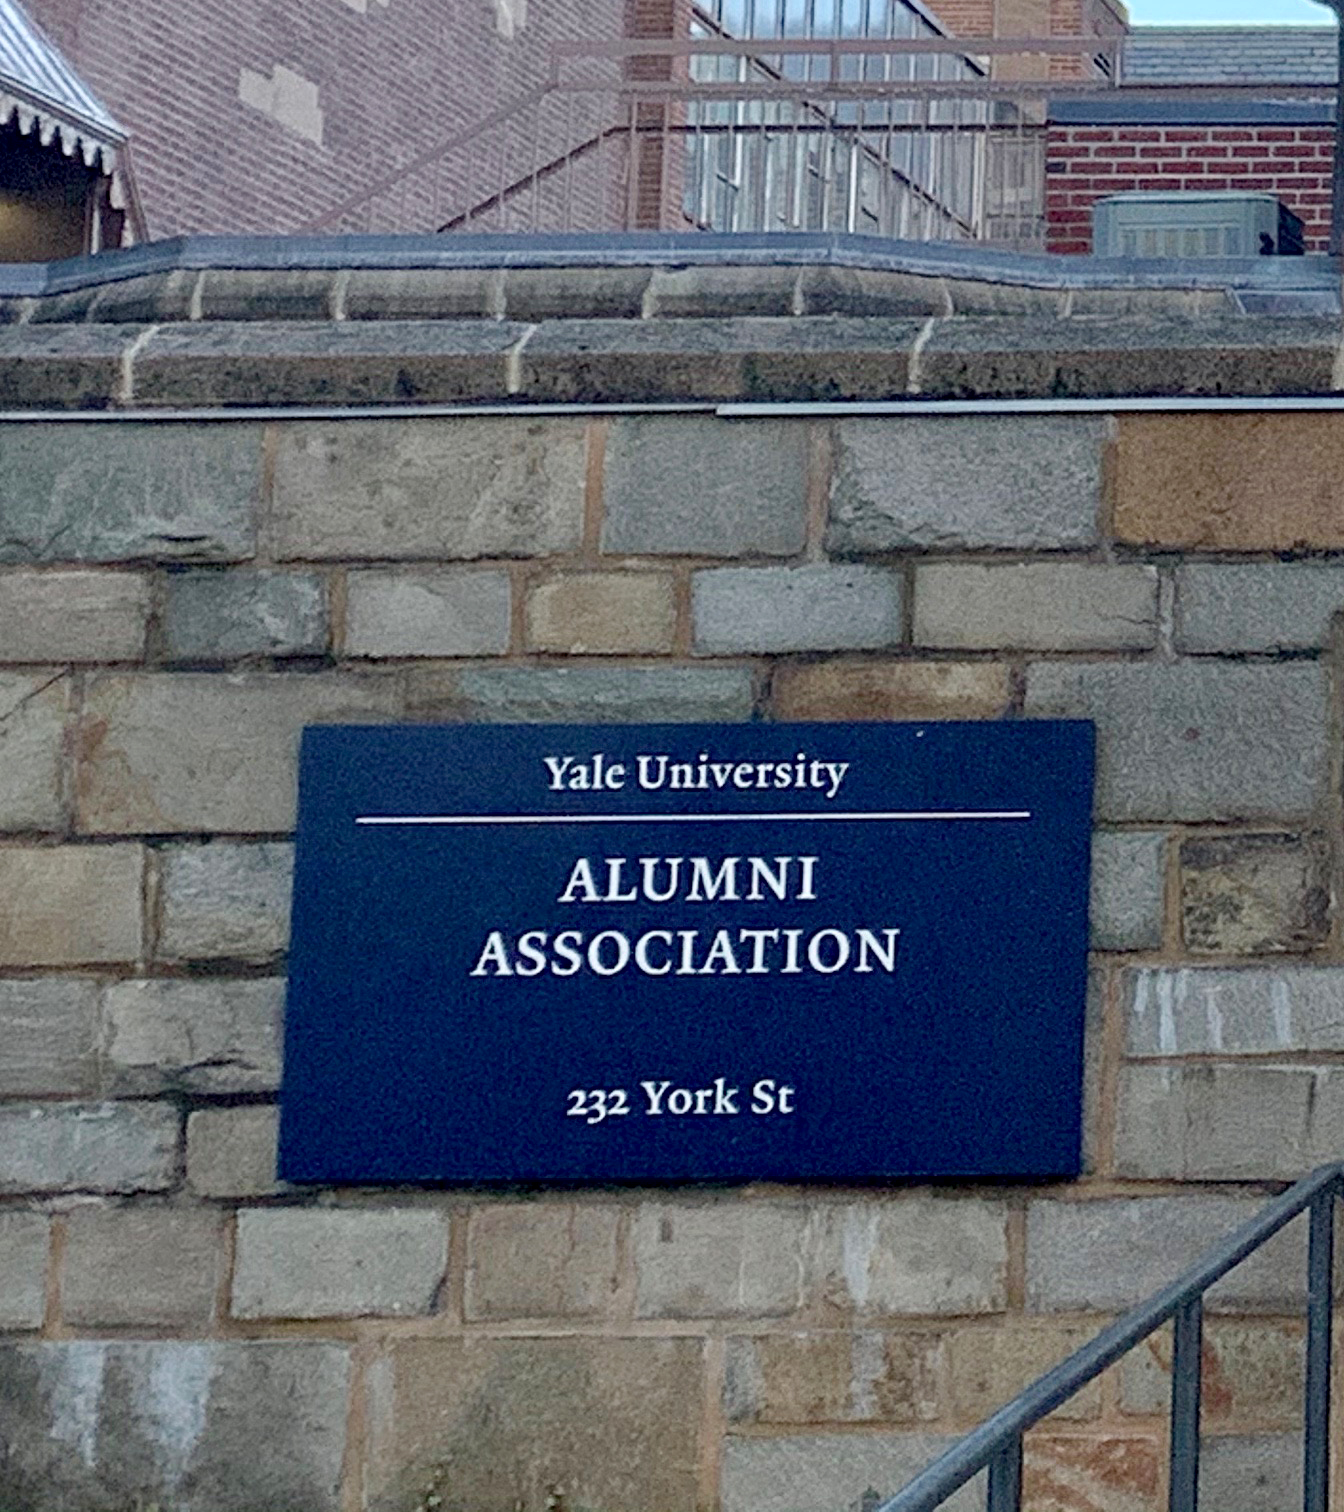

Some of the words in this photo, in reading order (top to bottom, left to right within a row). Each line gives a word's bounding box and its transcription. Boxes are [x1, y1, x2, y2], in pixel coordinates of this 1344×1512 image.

[543, 753, 626, 790] Yale
[637, 752, 850, 798] University
[557, 855, 819, 903] ALUMNI
[470, 928, 900, 976] ASSOCIATION
[567, 1088, 630, 1124] 232
[640, 1078, 739, 1115] York
[752, 1080, 794, 1114] St
